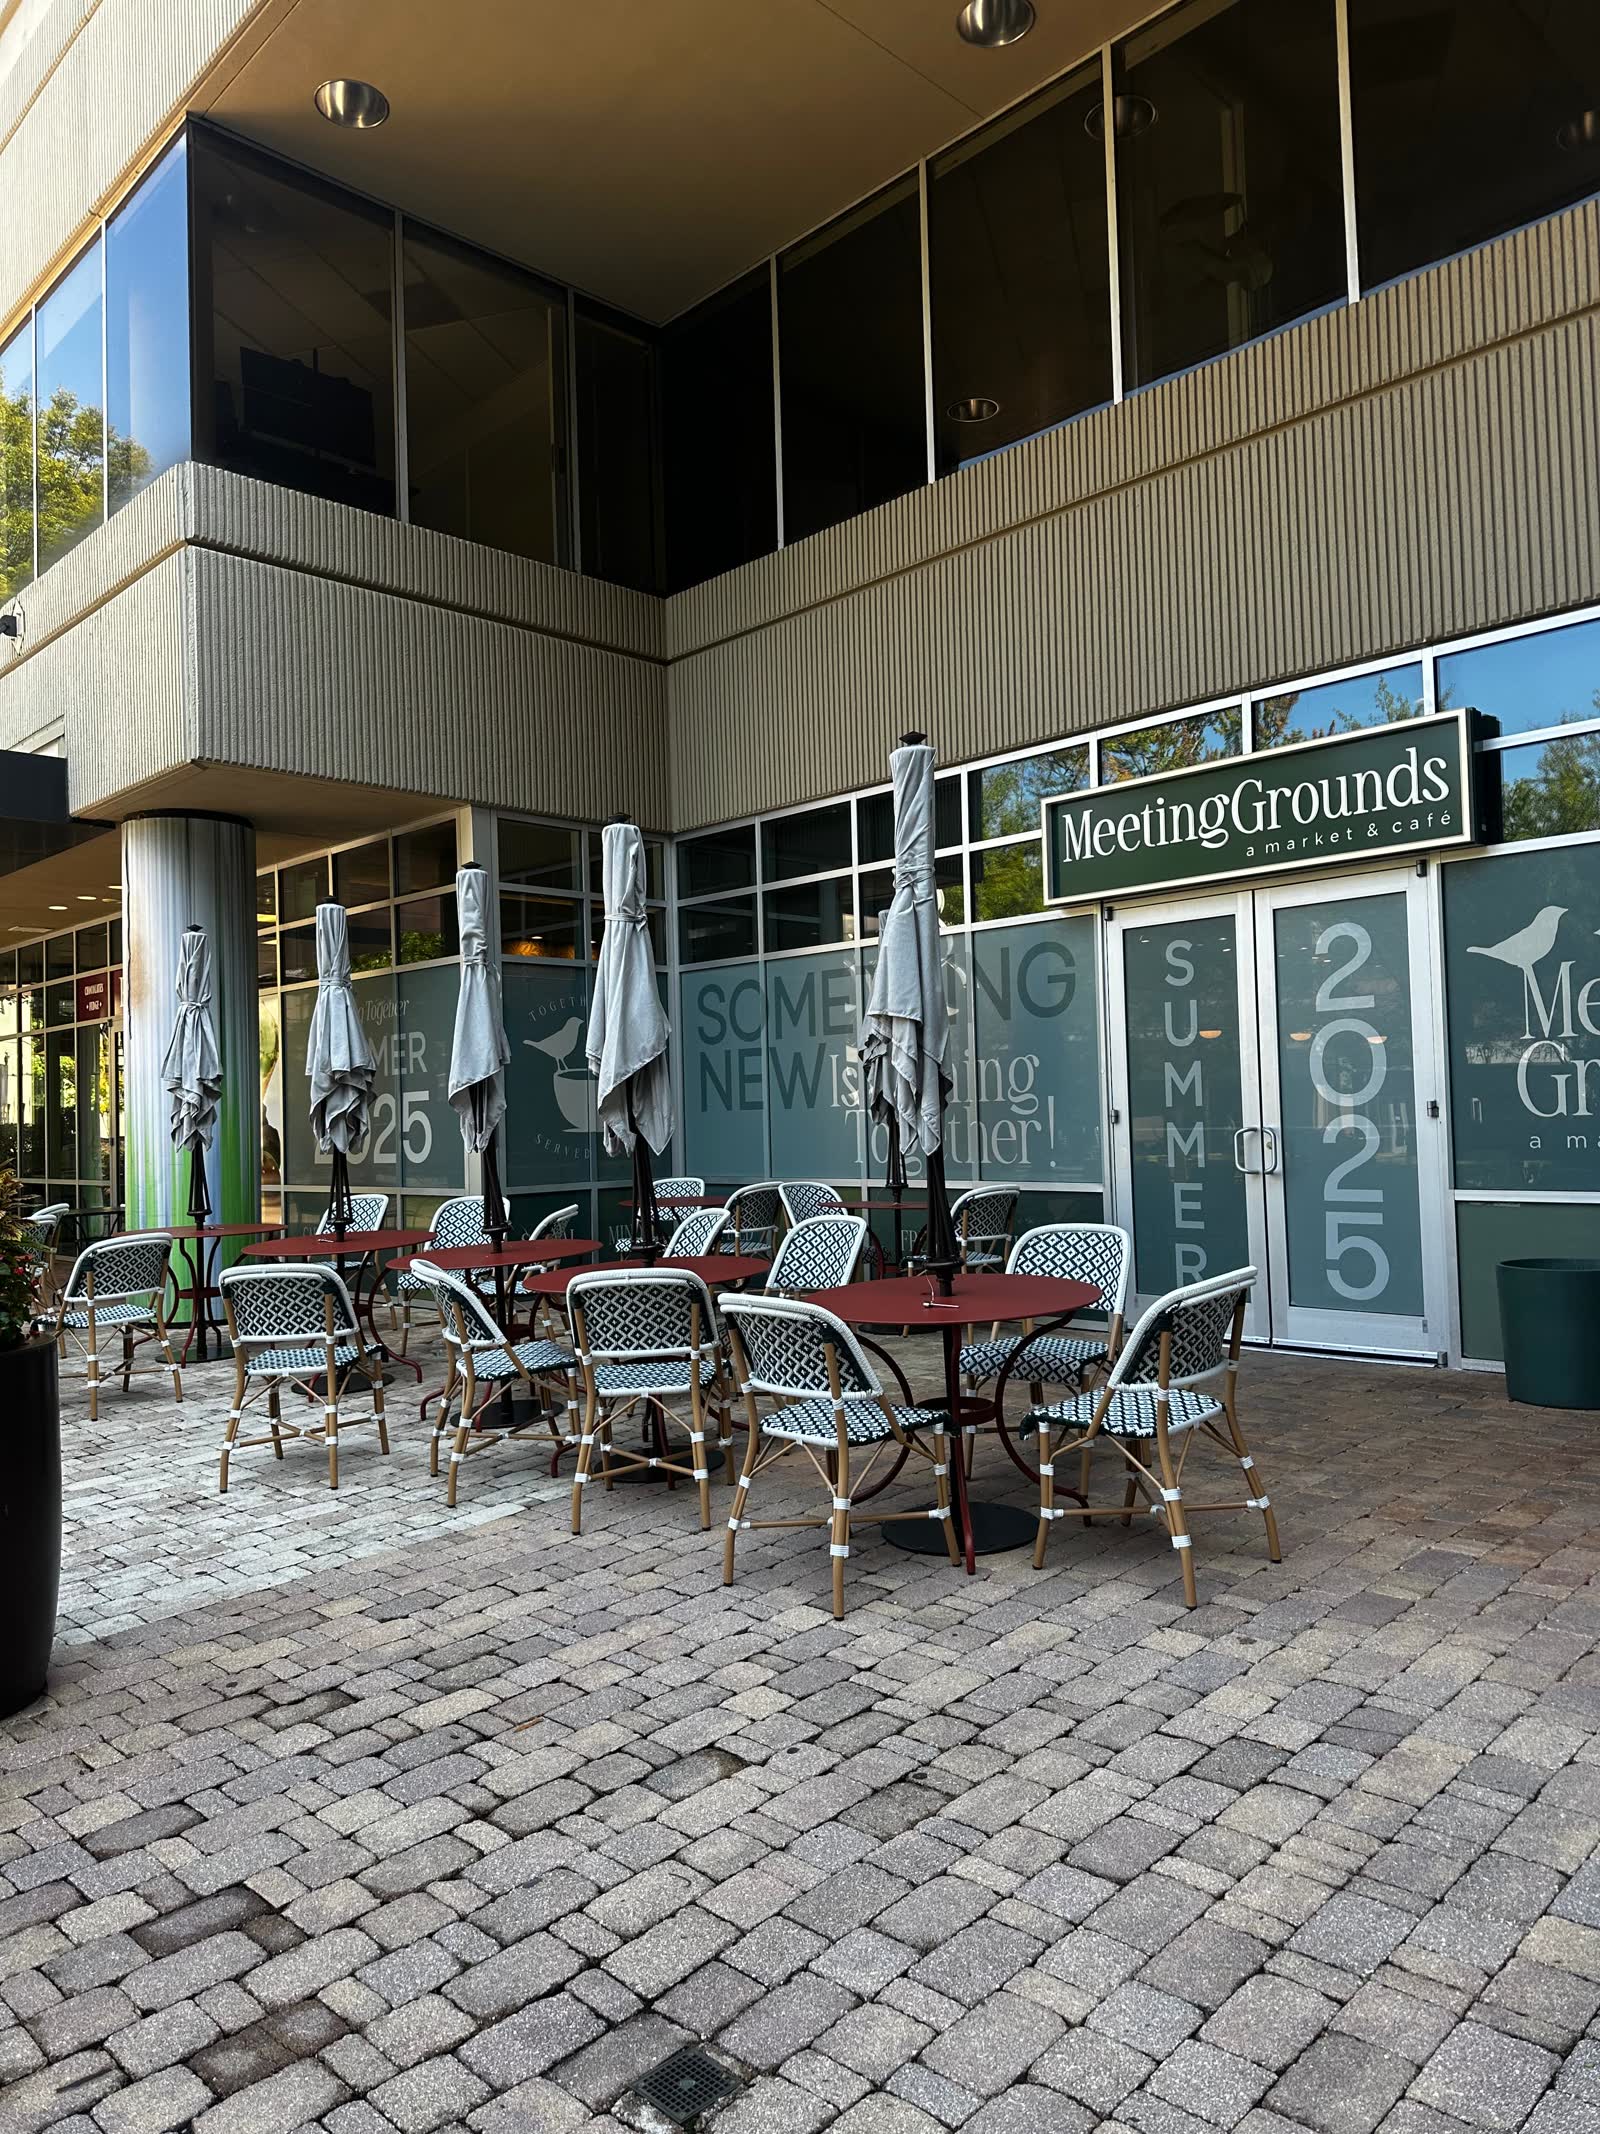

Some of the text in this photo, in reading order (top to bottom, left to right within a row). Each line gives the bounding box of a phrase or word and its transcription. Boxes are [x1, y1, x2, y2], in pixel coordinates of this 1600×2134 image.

[1062, 747, 1451, 862] MeetingGrounds
[1246, 809, 1452, 856] a market & café
[697, 941, 1076, 1046] SOMEING
[700, 1043, 826, 1113] NEW
[829, 1054, 860, 1108] Is
[1164, 939, 1208, 1288] SUMMER
[1309, 922, 1390, 1300] 2025
[1529, 1135, 1541, 1150] a
